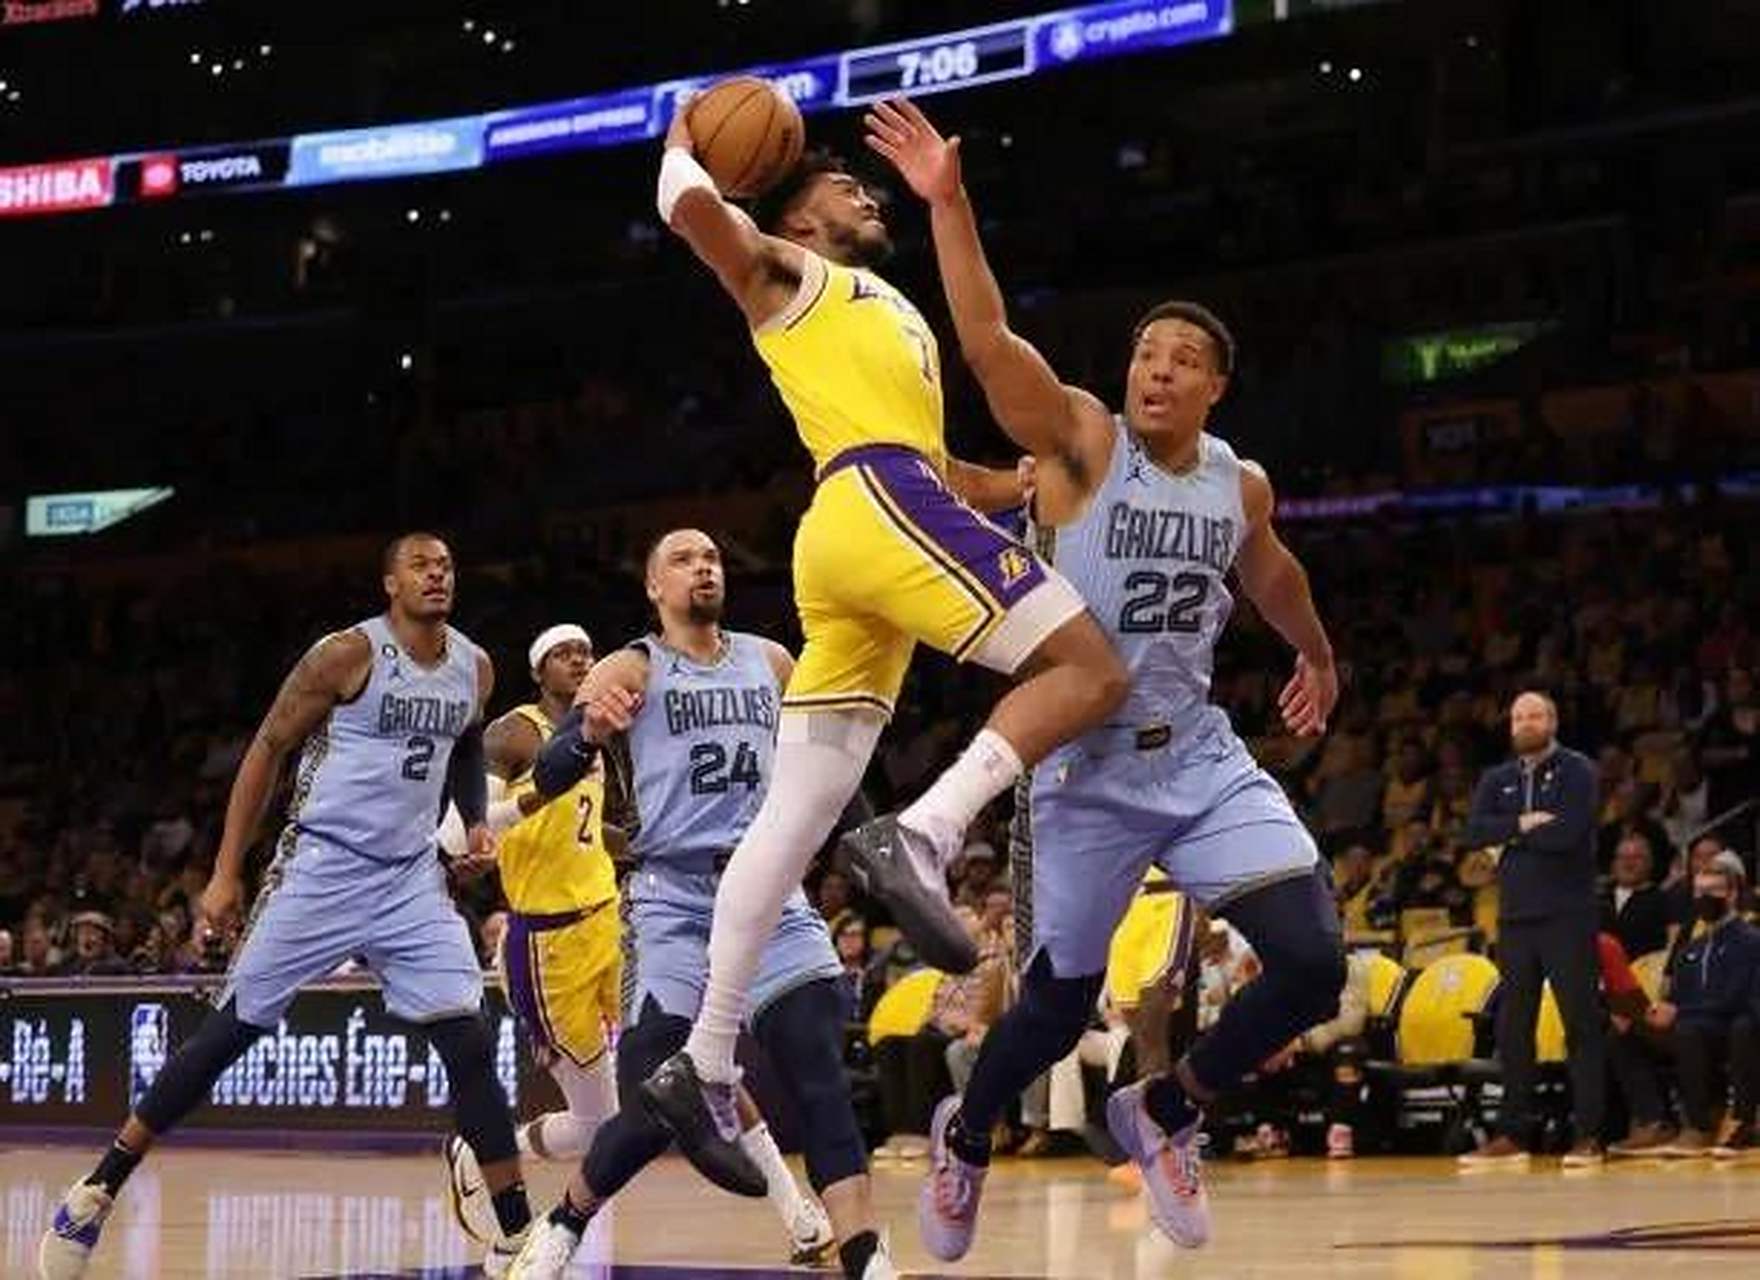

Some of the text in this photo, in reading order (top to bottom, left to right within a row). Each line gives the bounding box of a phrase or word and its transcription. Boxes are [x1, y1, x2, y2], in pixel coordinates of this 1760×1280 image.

[180, 156, 261, 182] TOYOTA
[1119, 571, 1209, 633] 22
[664, 685, 774, 736] GRIZZLIES
[402, 735, 435, 781] 2
[690, 740, 761, 796] 24
[577, 794, 594, 844] 2
